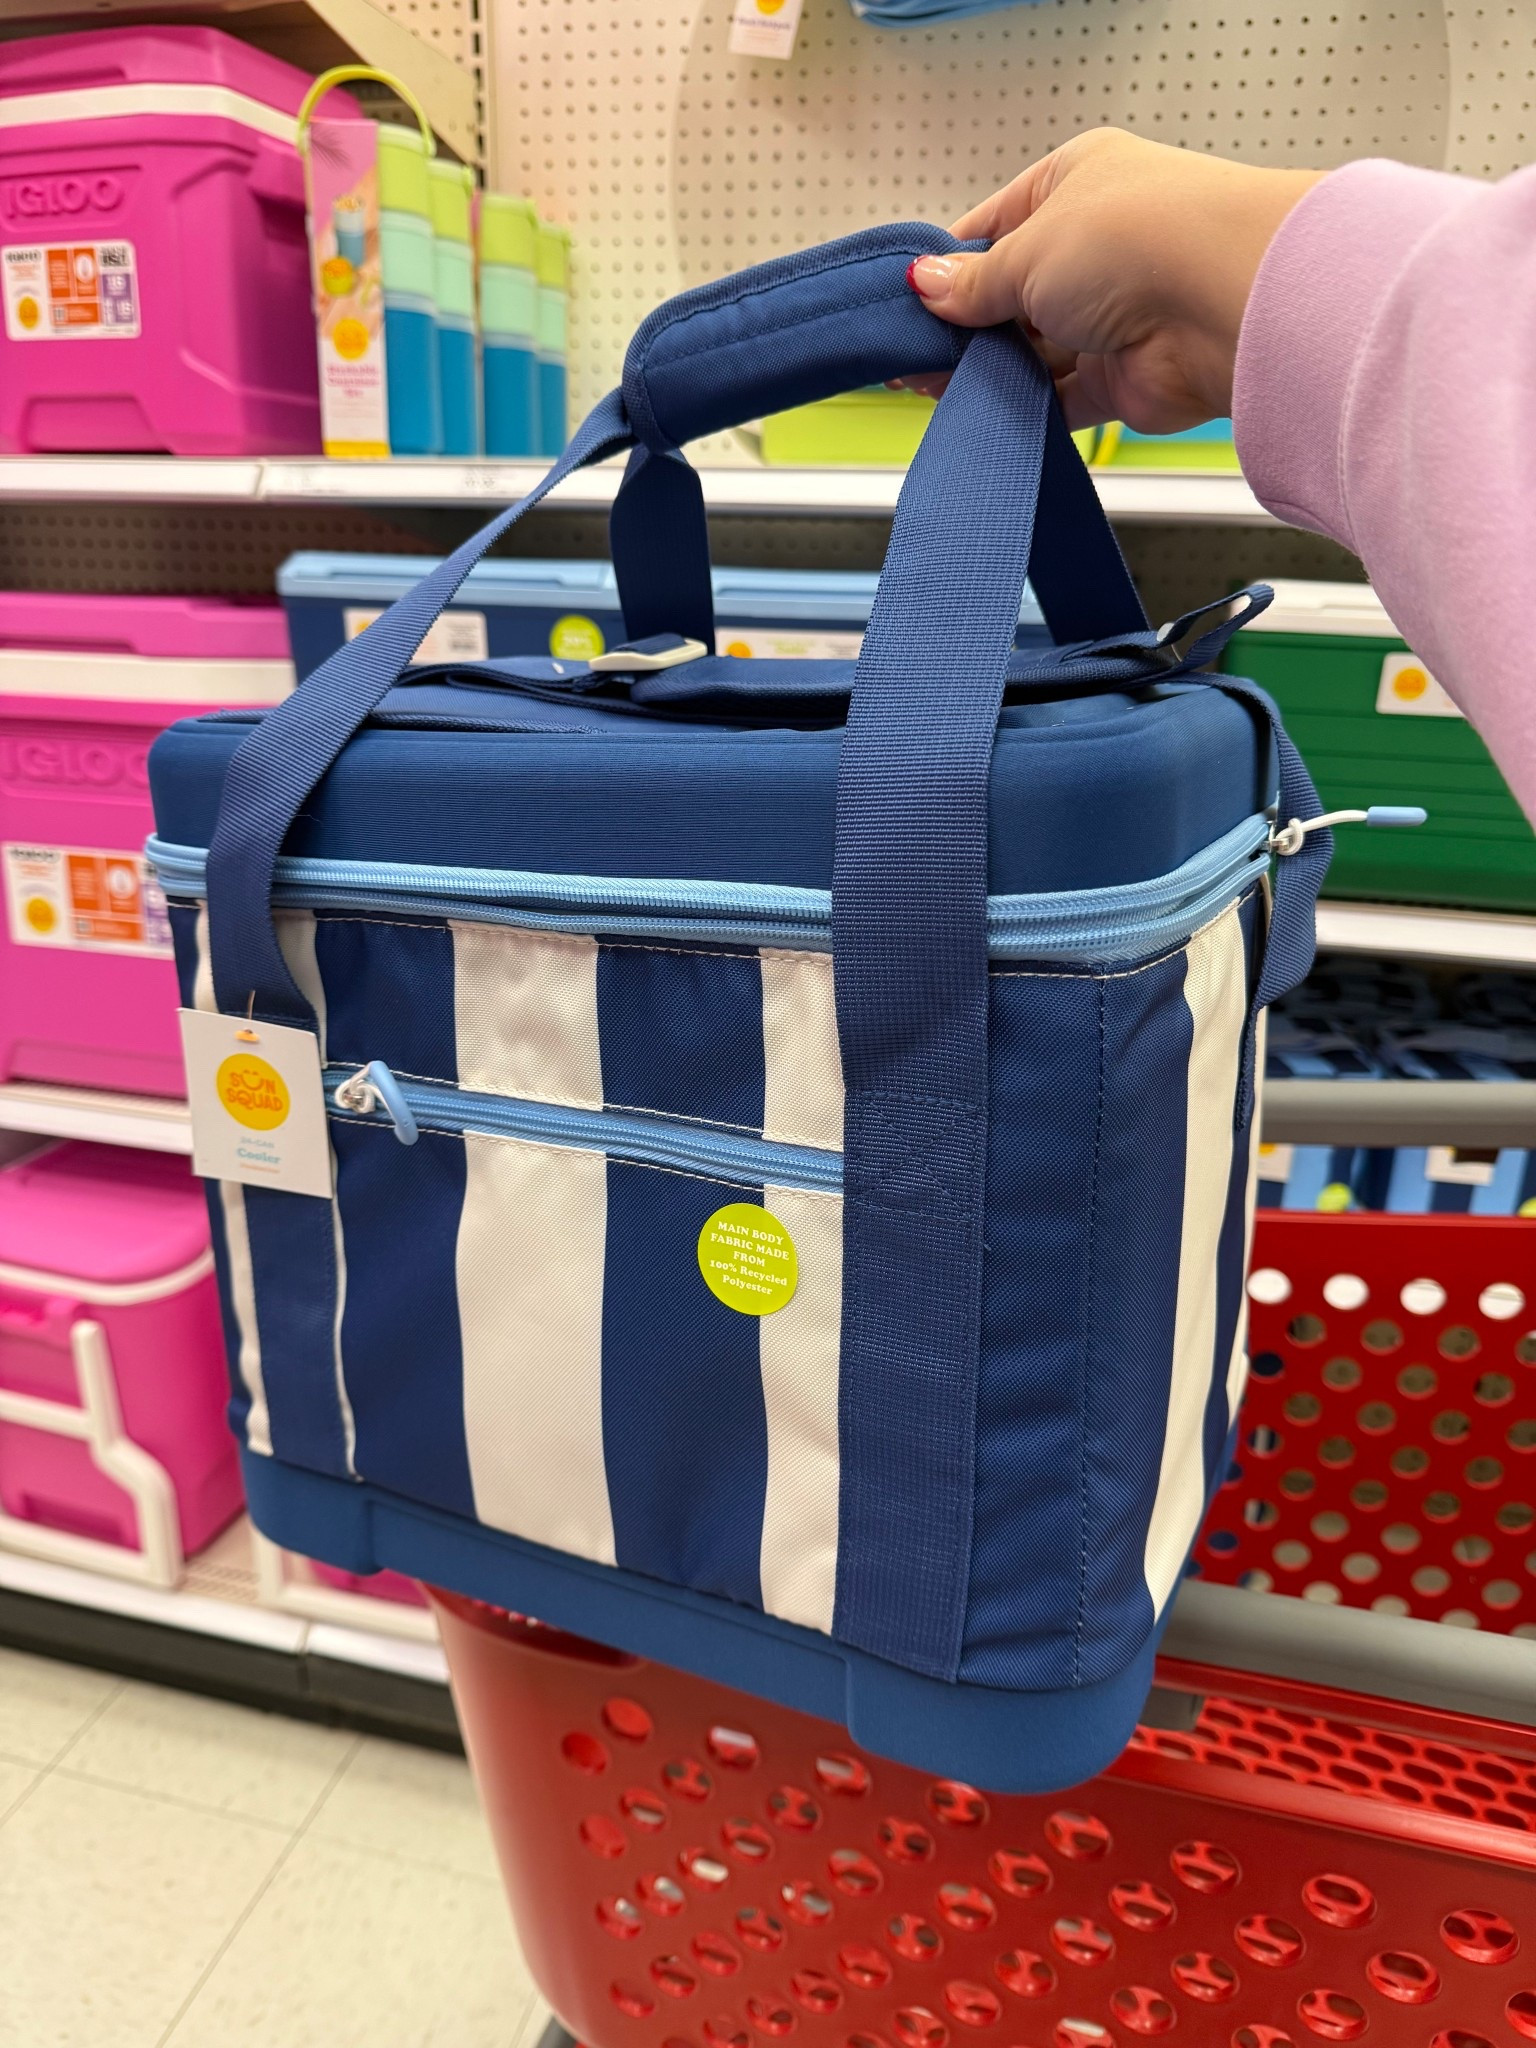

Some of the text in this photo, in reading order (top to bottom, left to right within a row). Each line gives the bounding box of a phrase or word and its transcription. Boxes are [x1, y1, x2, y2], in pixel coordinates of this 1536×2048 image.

[7, 178, 124, 220] IGLOO
[229, 1070, 276, 1094] SUN
[226, 1087, 283, 1111] SQUAD
[236, 1147, 281, 1164] Cooler
[717, 1221, 784, 1245] MAIN BODY
[710, 1232, 789, 1260] FABRIC MADE
[733, 1250, 765, 1267] FROM
[710, 1259, 787, 1286] 100% Recycled
[722, 1274, 773, 1295] Polyester
